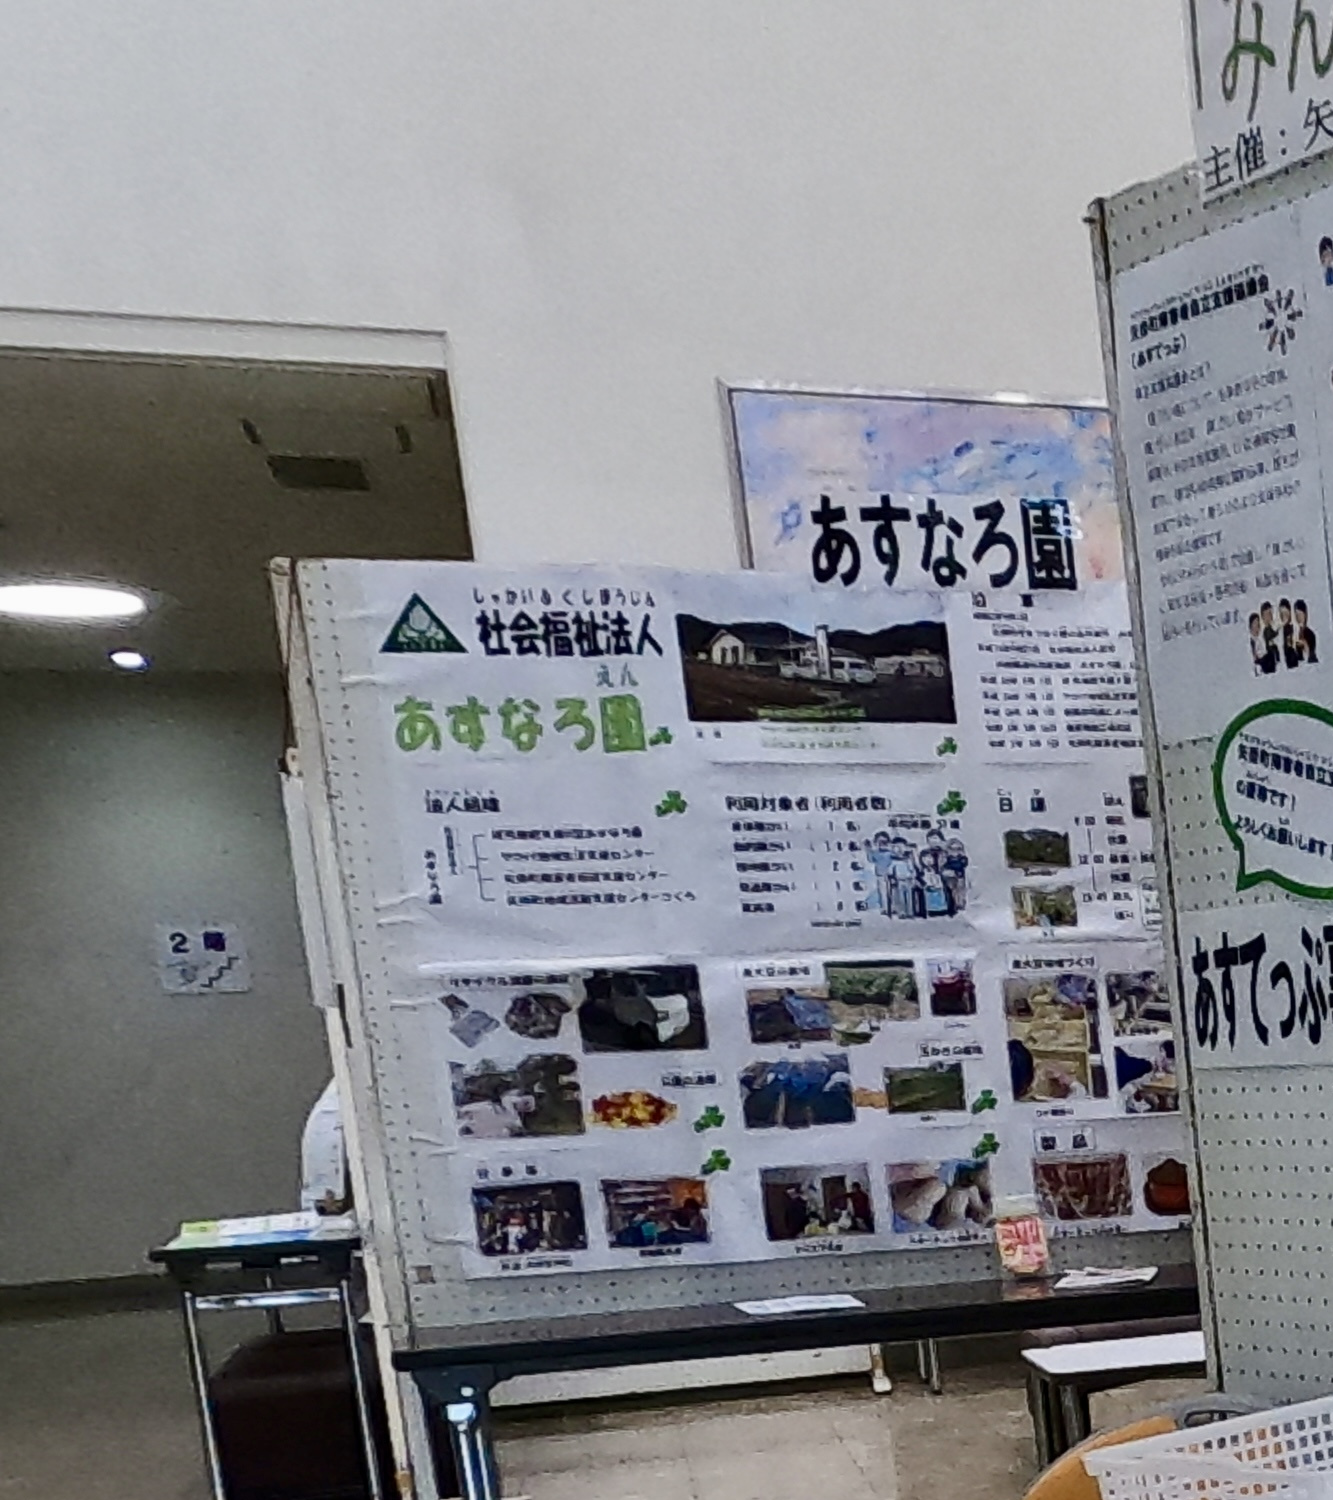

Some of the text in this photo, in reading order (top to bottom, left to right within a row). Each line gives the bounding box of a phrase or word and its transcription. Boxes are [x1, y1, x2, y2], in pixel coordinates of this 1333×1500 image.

[810, 494, 1078, 591] あすなろ園
[476, 609, 665, 658] 社会福祉法人
